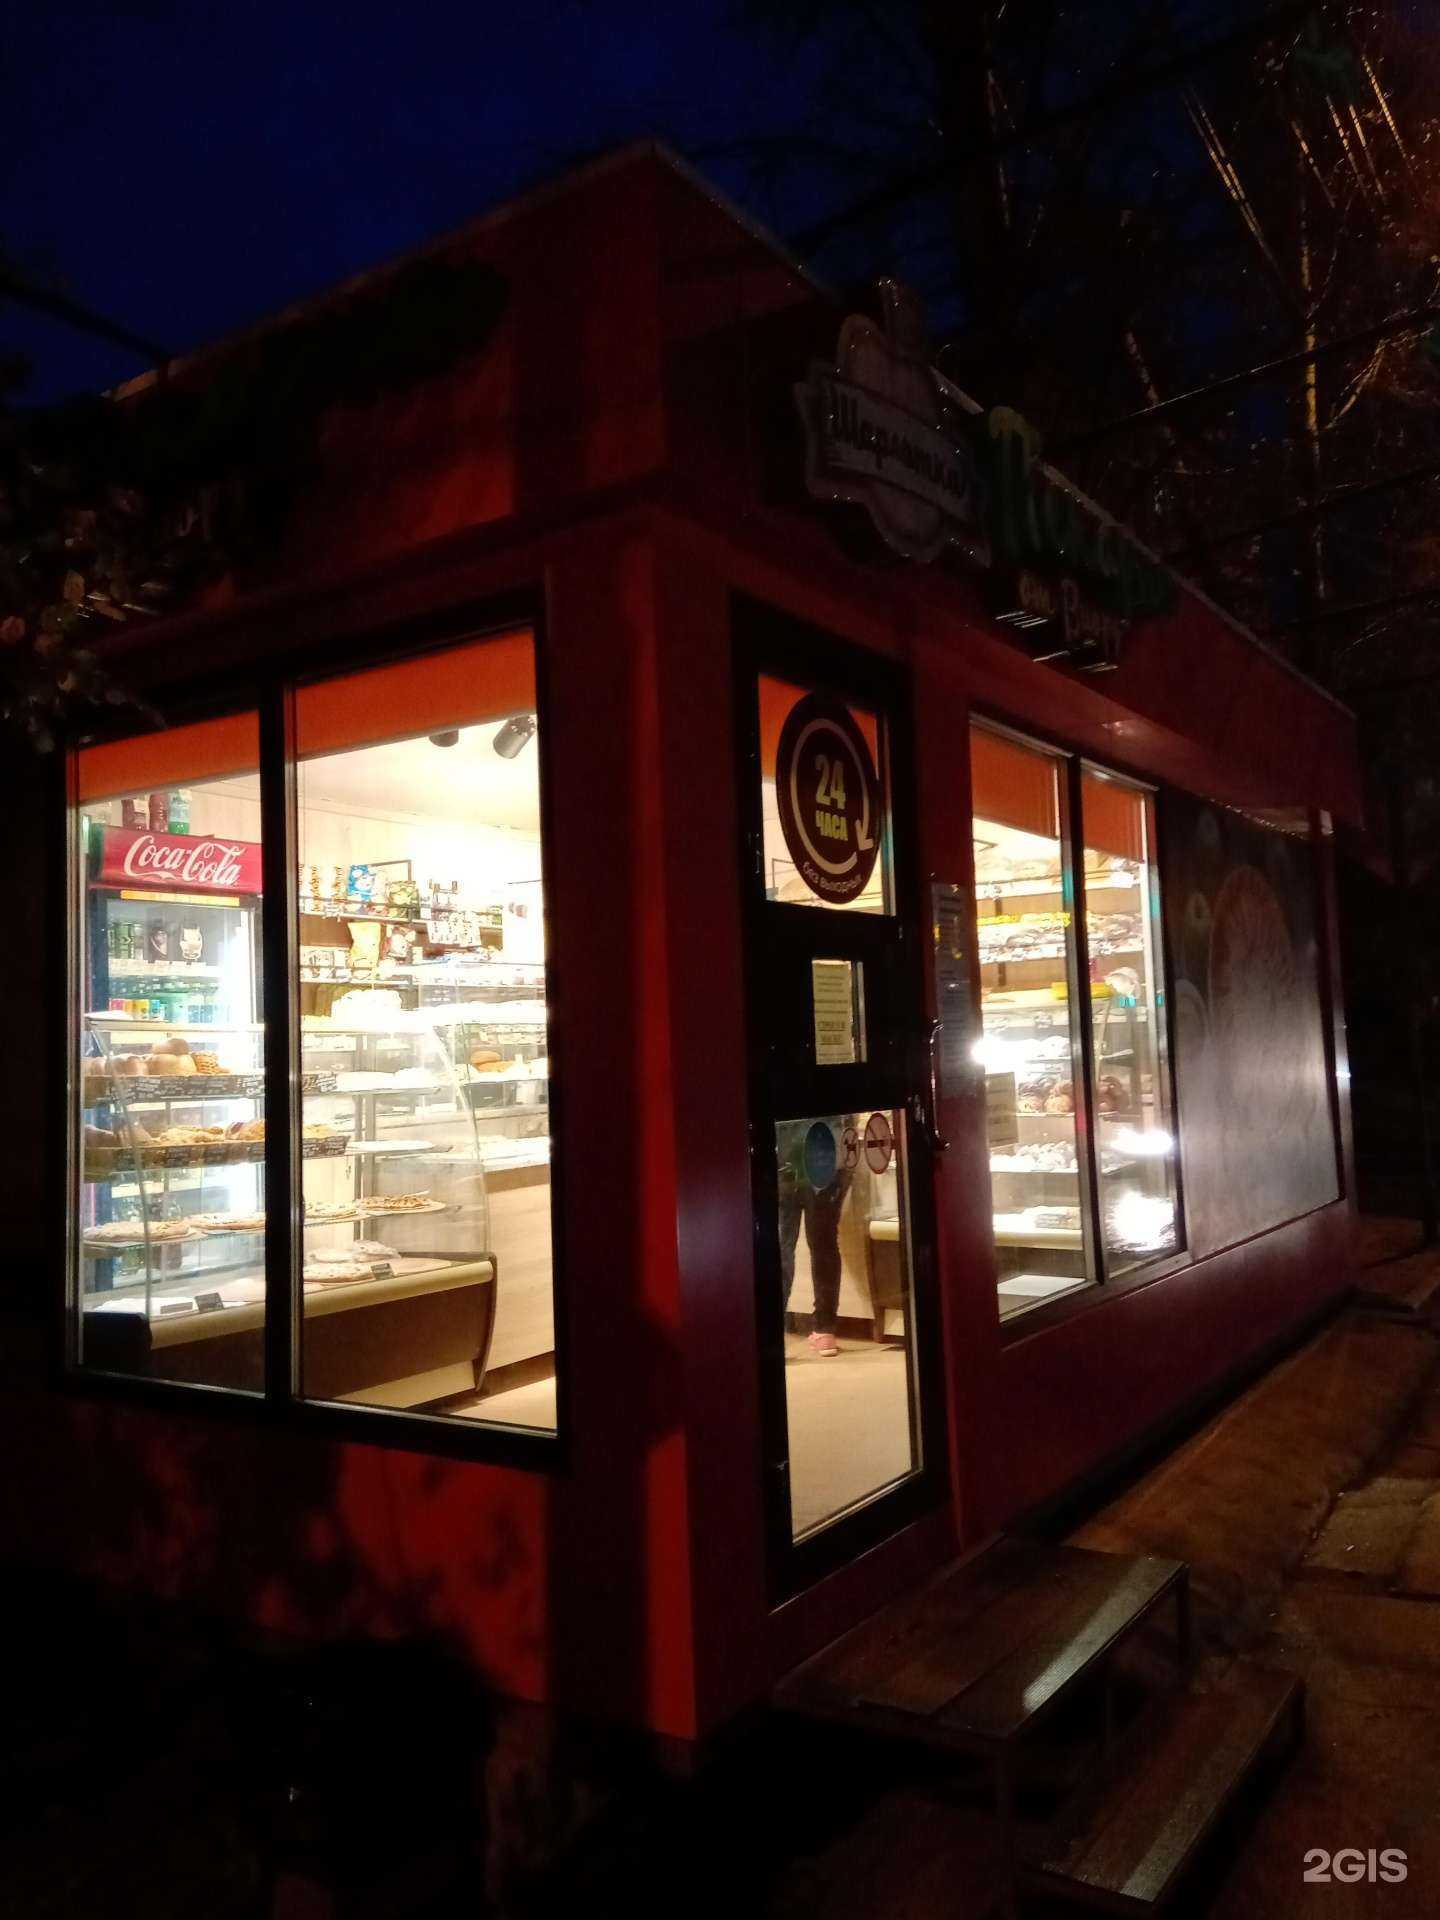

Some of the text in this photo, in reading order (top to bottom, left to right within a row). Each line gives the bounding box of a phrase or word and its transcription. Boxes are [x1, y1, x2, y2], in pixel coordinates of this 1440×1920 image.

[816, 754, 846, 810] 24
[816, 810, 848, 841] ЧАСА
[123, 835, 248, 886] Coca-Cola
